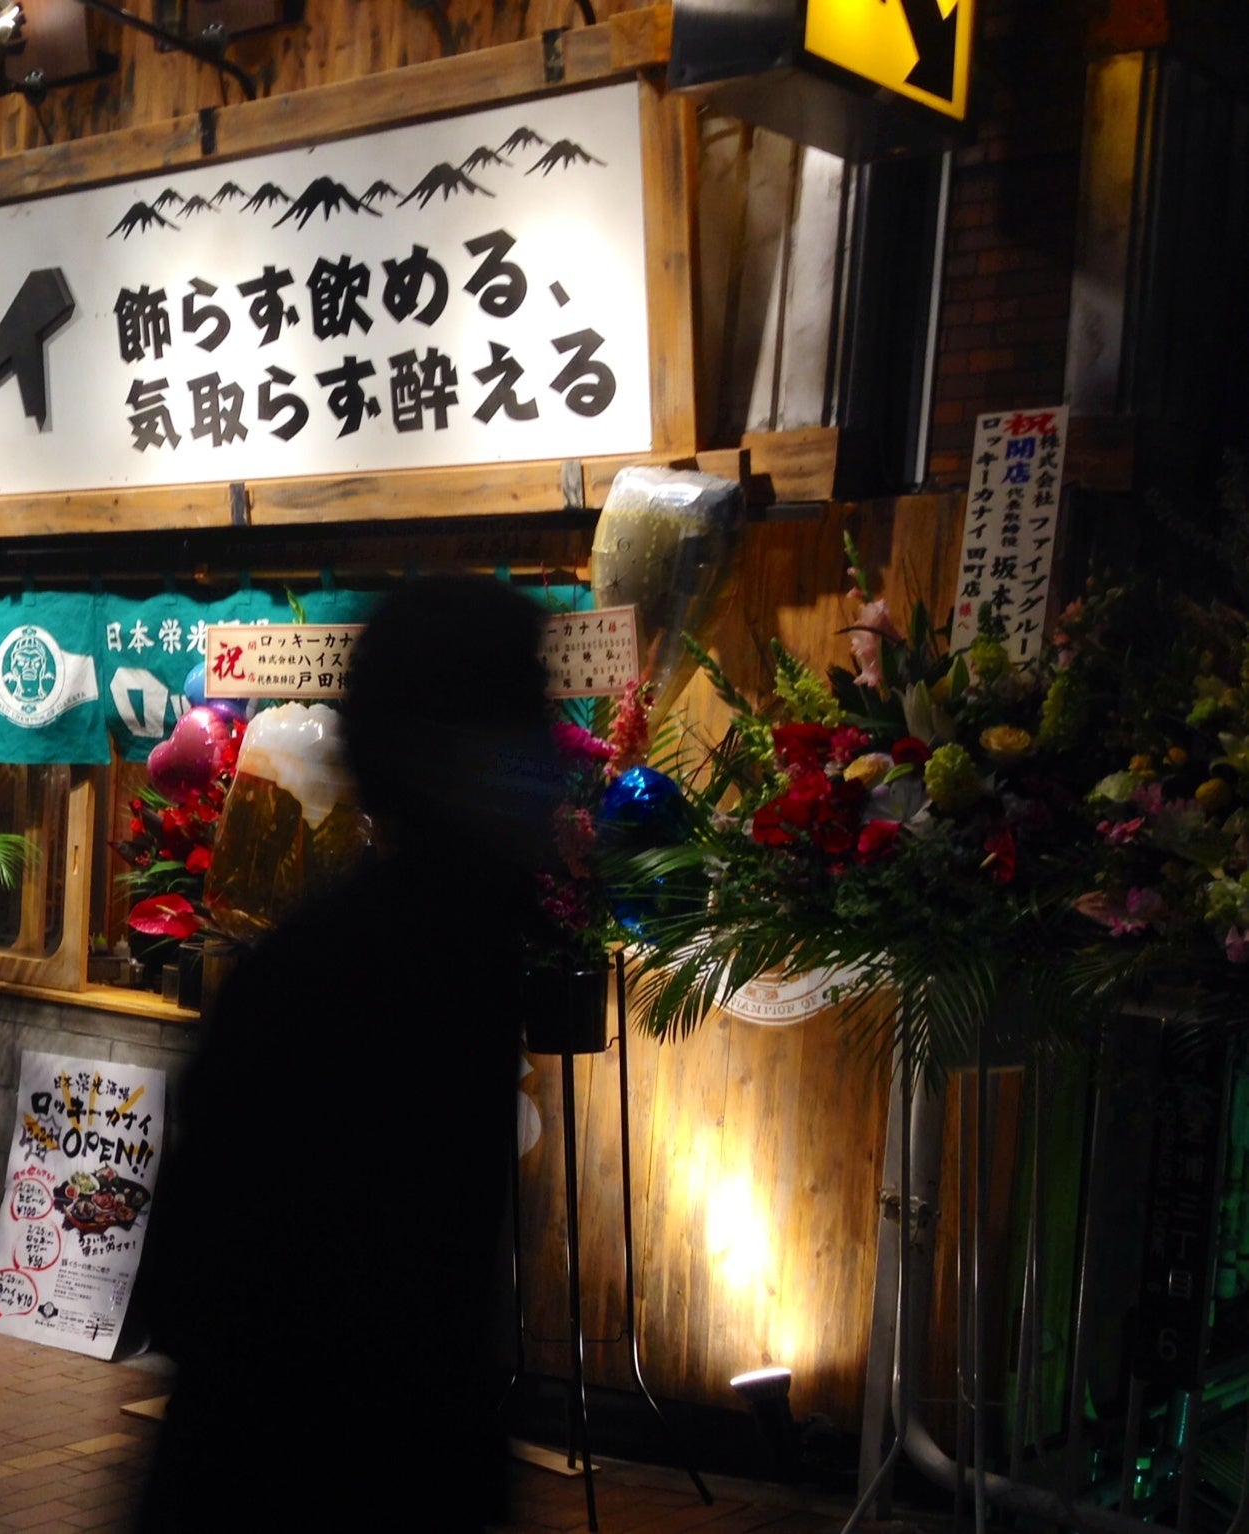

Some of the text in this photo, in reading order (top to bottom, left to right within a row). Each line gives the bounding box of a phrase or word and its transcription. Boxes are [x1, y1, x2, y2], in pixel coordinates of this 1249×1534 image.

[113, 229, 570, 364] 飾らず飲める、
[126, 328, 617, 452] 気取らず酔える
[1003, 413, 1059, 436] 祝
[1002, 437, 1036, 484] 開店
[106, 618, 270, 655] 日本栄光
[211, 641, 246, 681] 祝
[31, 1092, 152, 1136] ロッキーカナイ
[62, 1127, 154, 1178] OPEN!!
